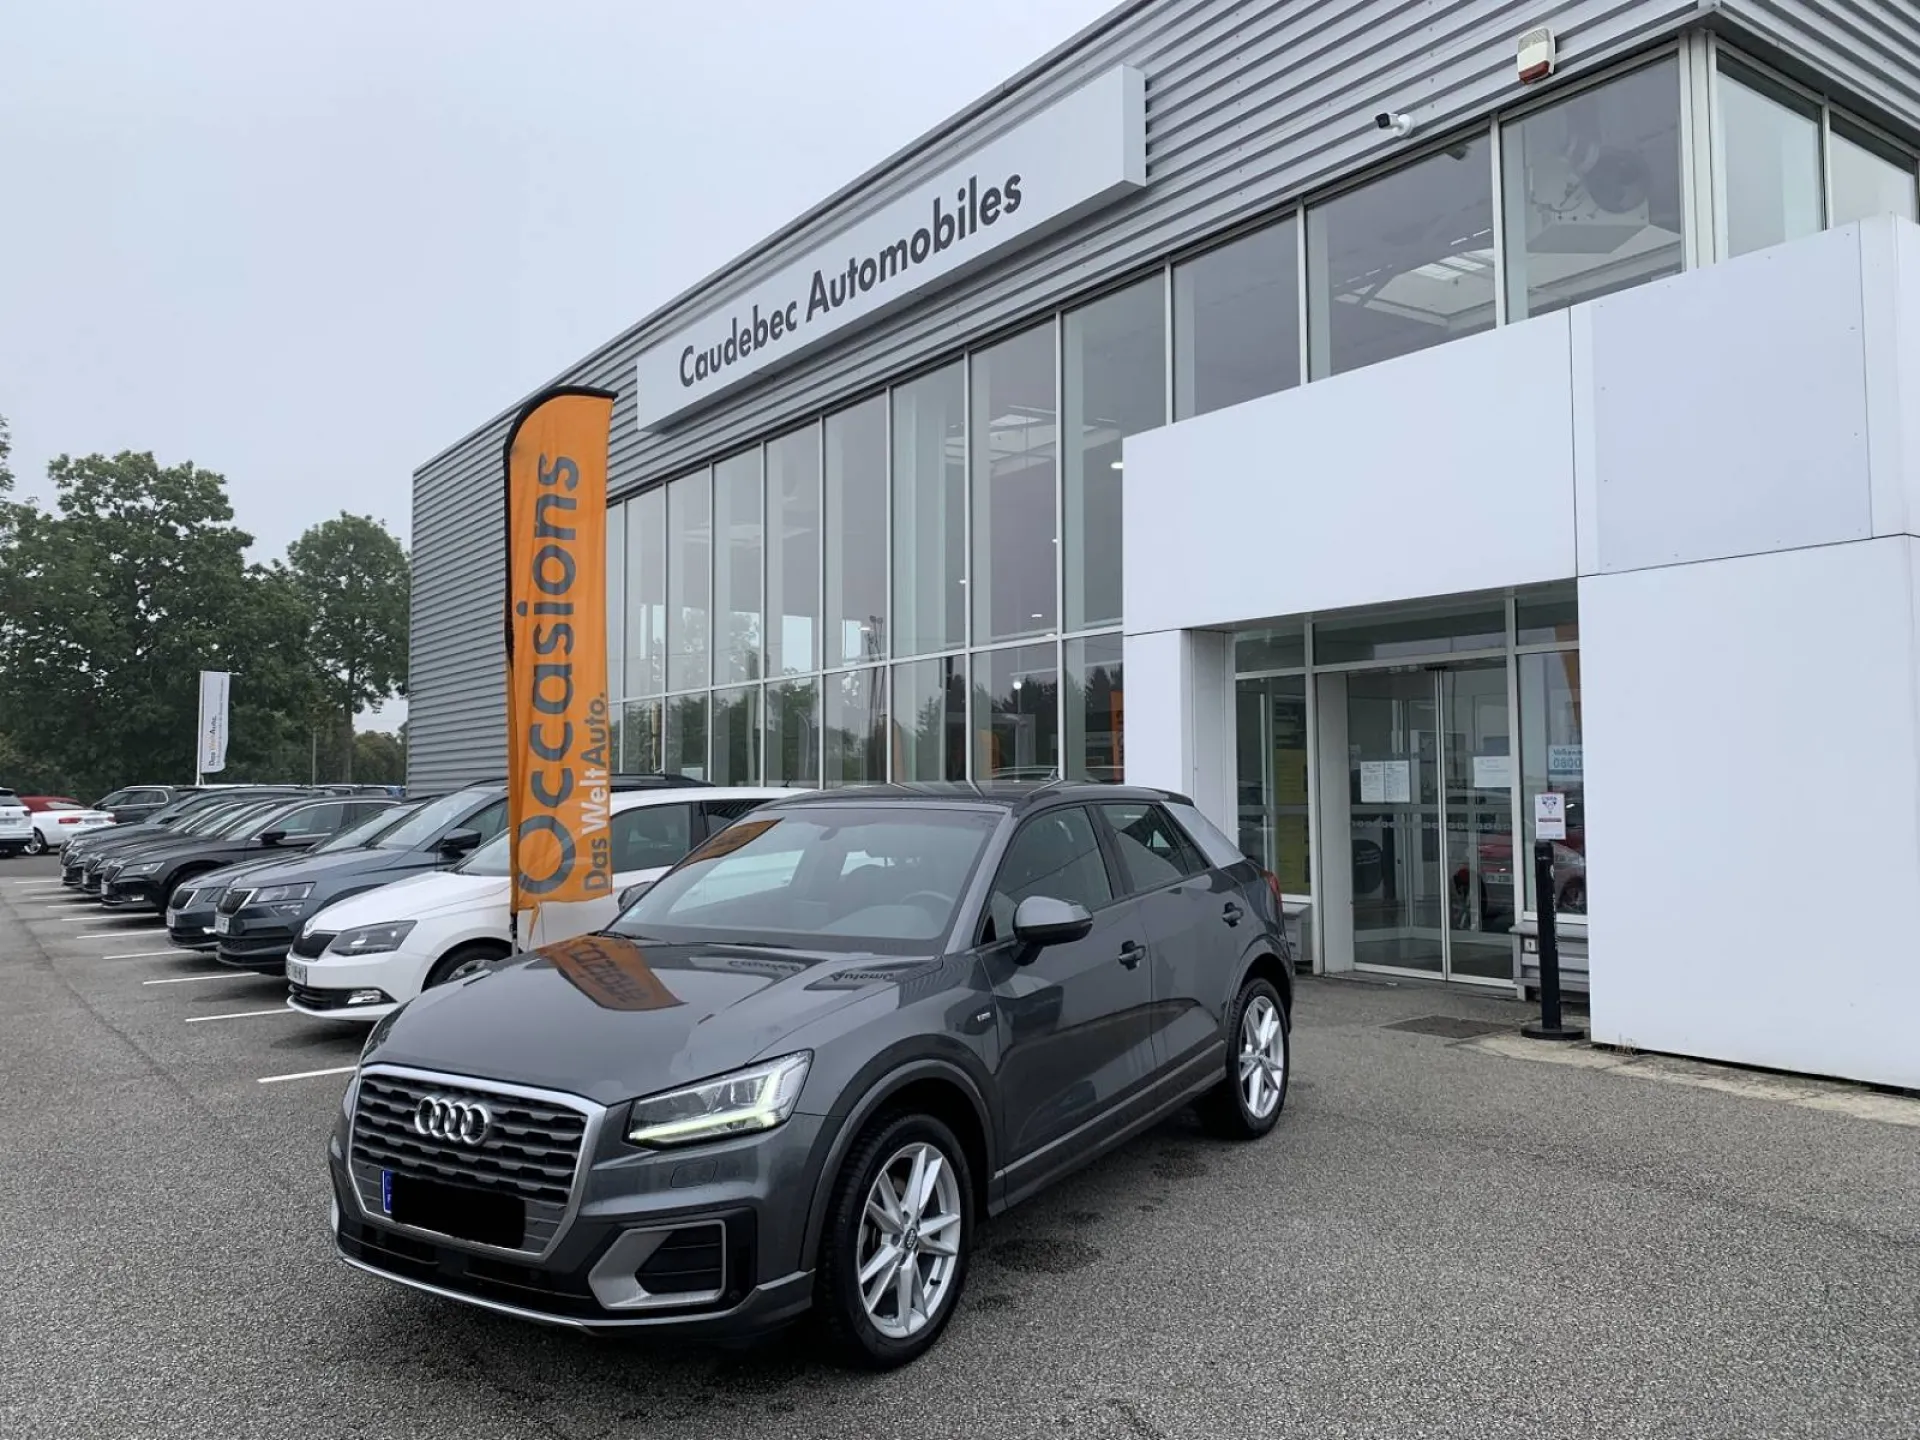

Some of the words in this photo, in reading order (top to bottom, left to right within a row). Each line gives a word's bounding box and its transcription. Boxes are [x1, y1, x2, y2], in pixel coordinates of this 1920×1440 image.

[680, 301, 797, 388] Caudebec
[805, 174, 1022, 324] Automobiles
[516, 452, 580, 895] Occasions
[579, 691, 608, 835] WeltAuto.
[583, 837, 609, 891] Das
